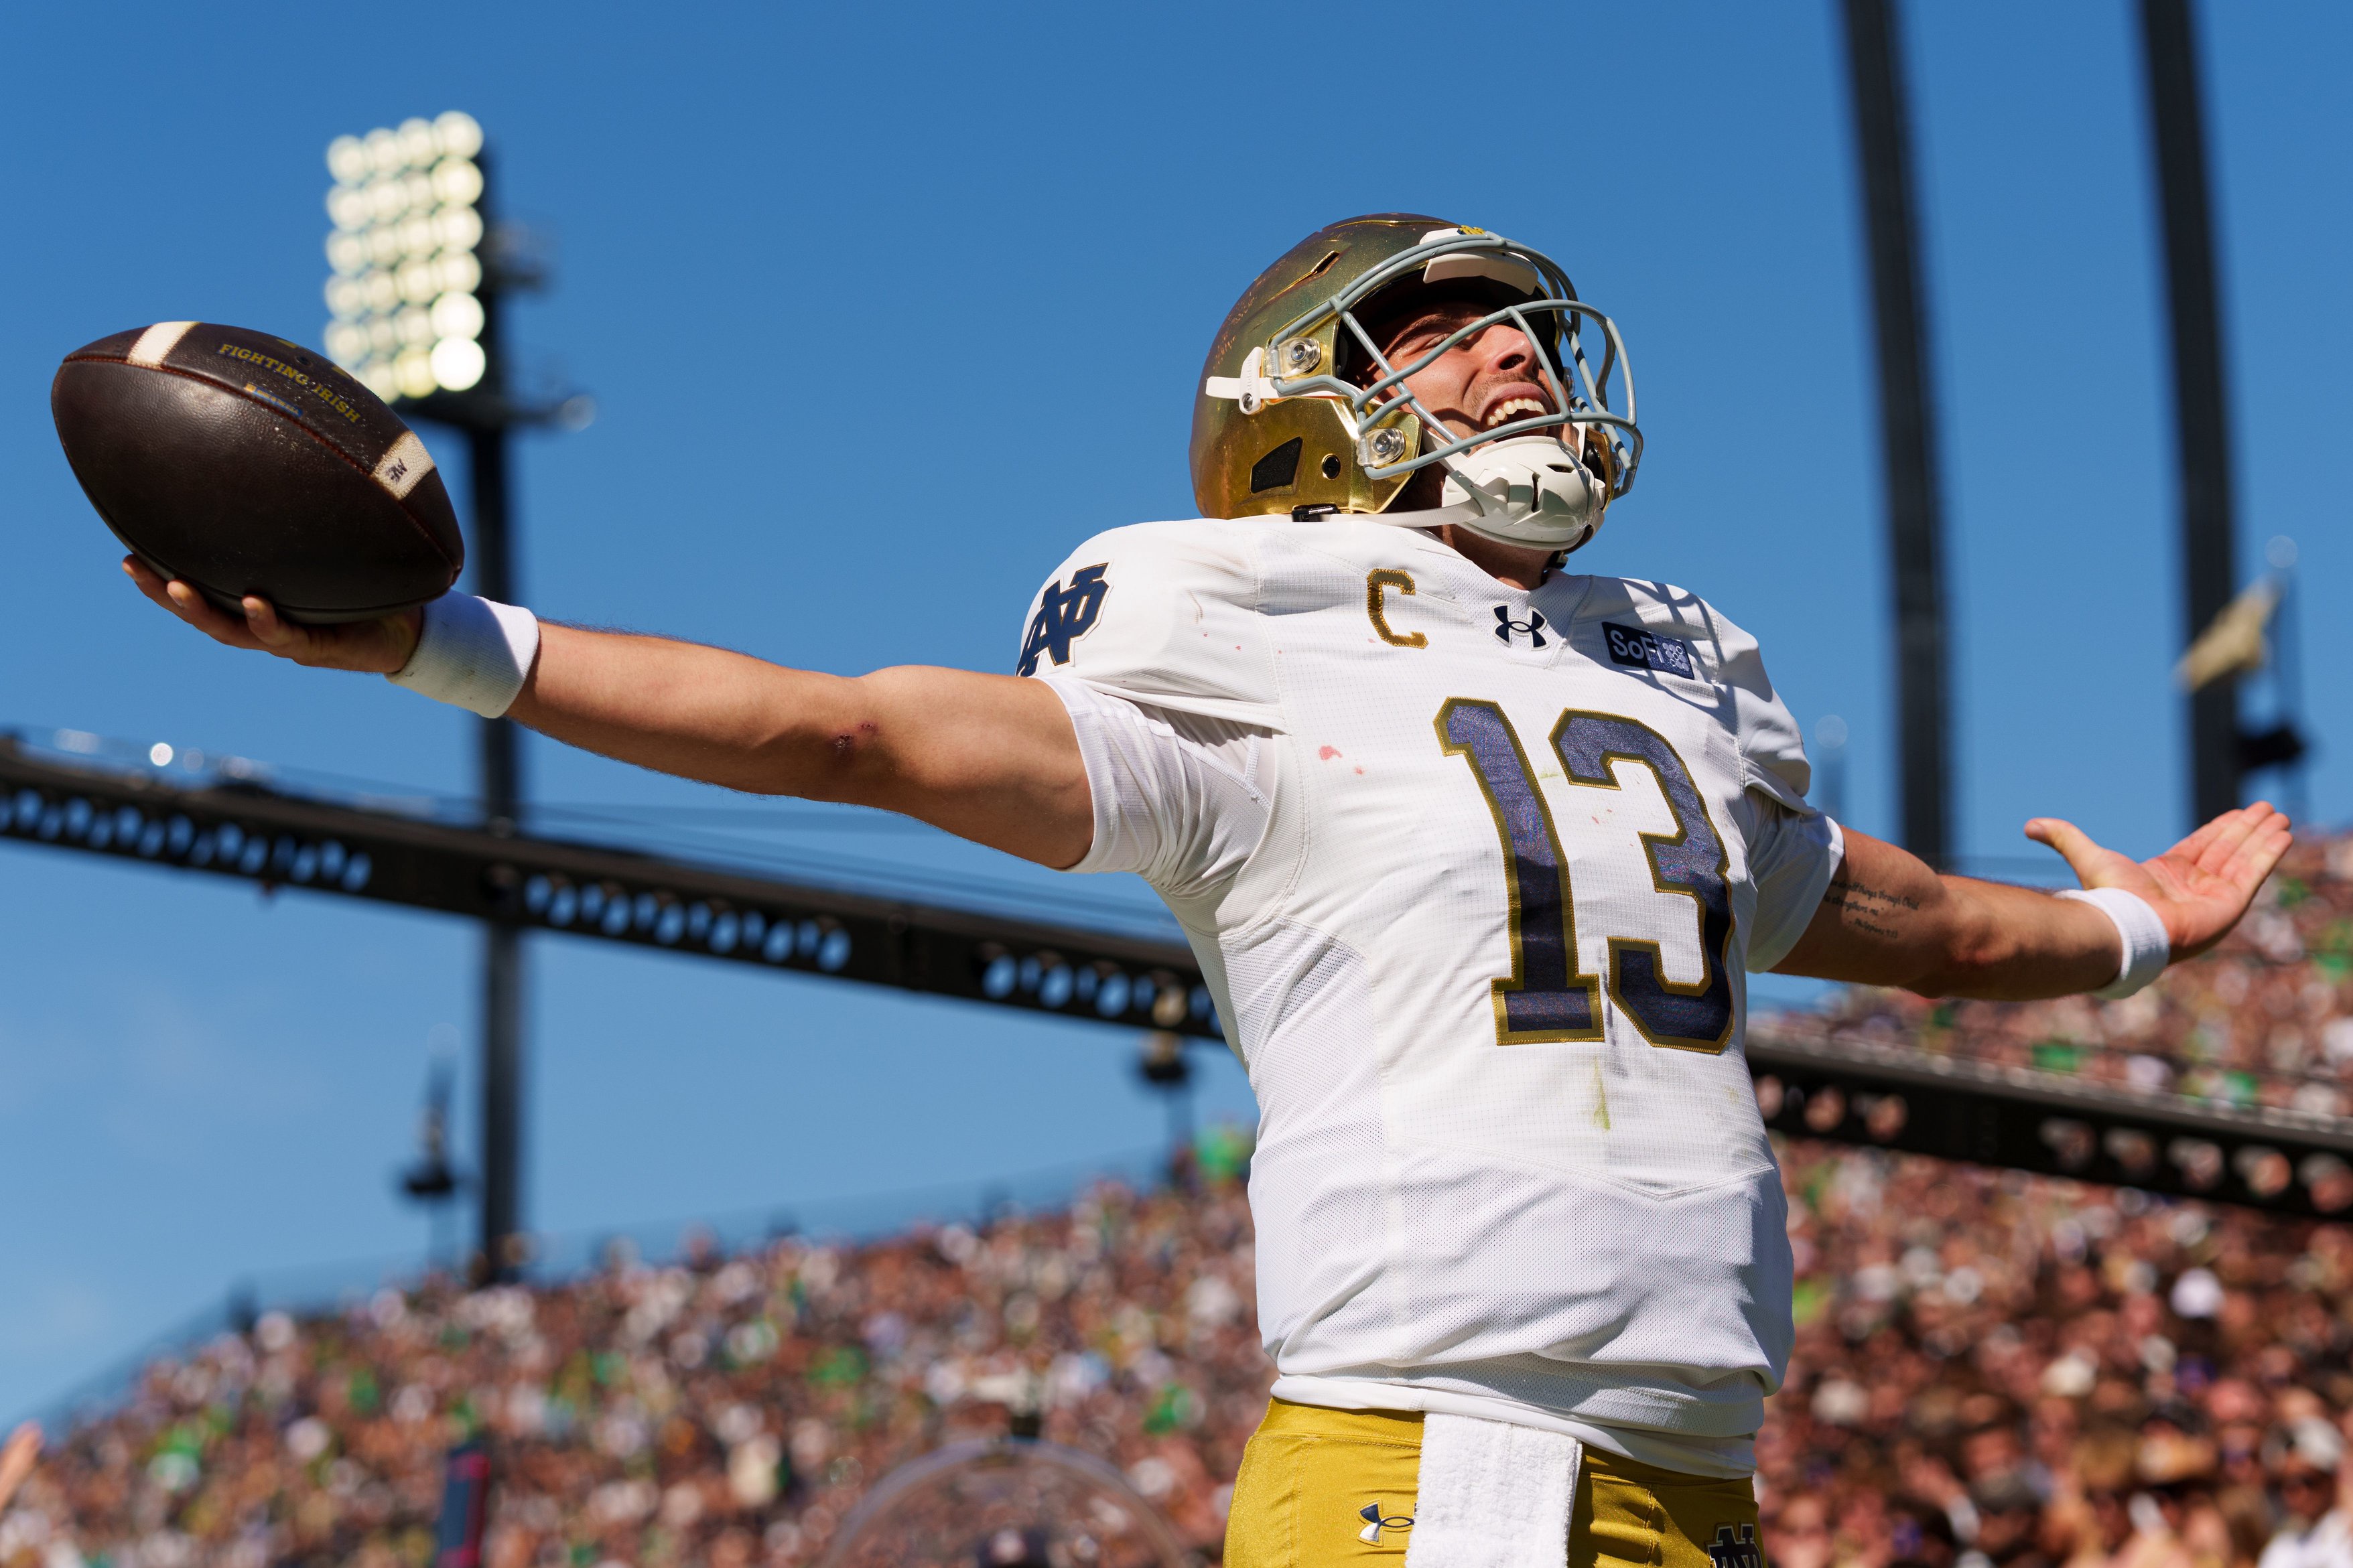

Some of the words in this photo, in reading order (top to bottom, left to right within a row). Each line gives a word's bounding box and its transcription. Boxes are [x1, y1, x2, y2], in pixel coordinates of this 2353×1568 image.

[218, 343, 310, 386] FIGHTING
[311, 382, 362, 423] IRISH
[1367, 568, 1428, 649] C
[1609, 630, 1665, 664] SoFi
[1433, 696, 1735, 1055] 13
